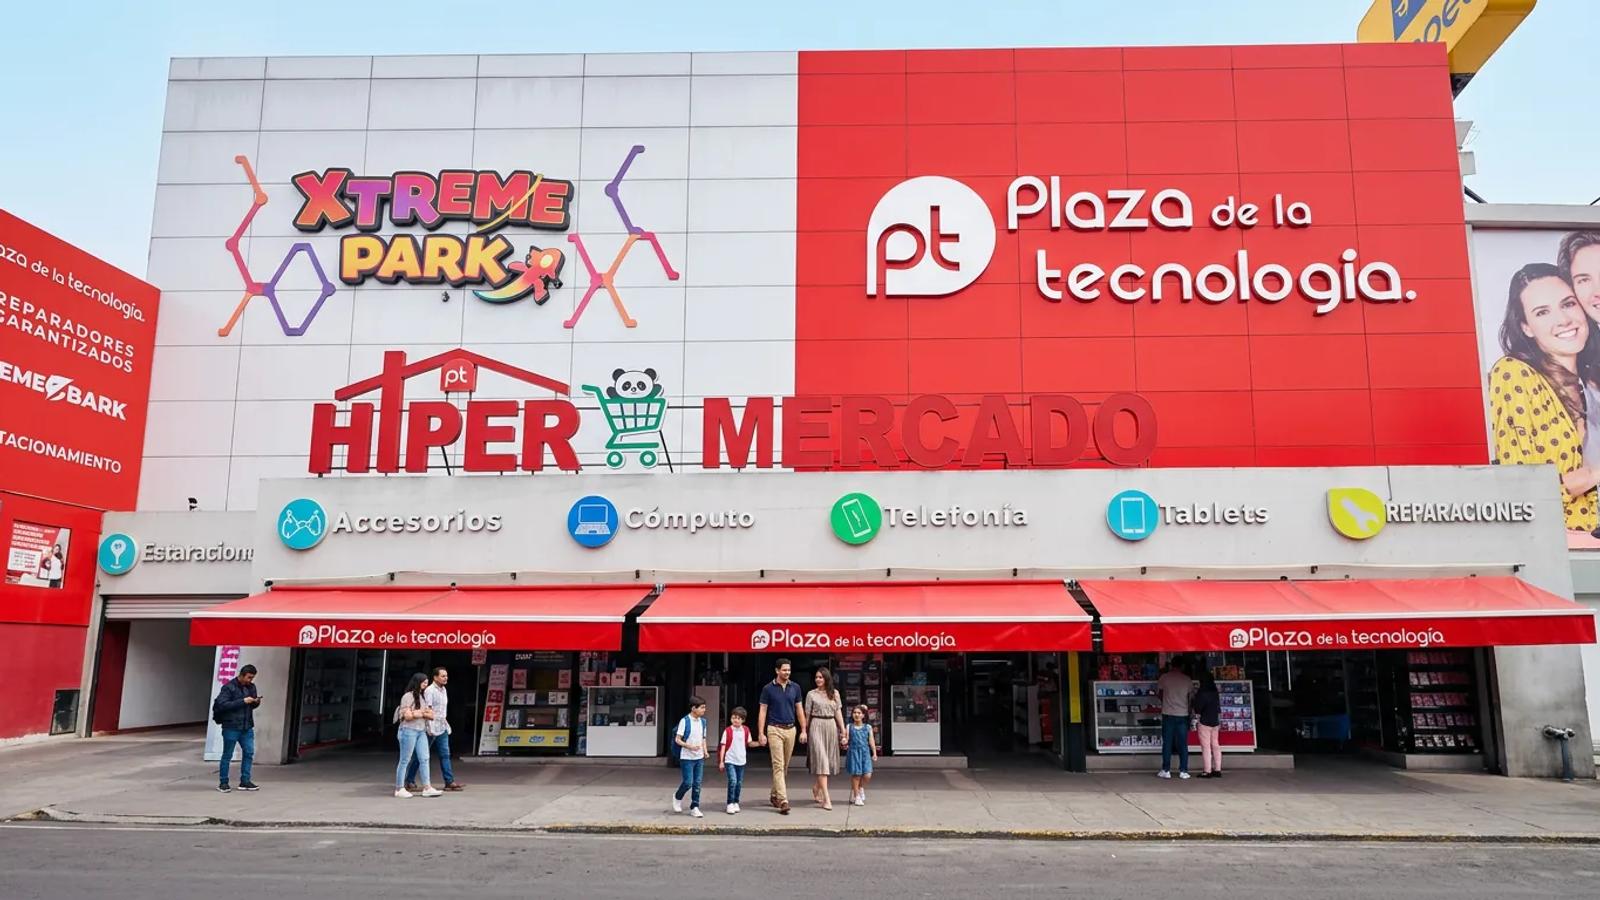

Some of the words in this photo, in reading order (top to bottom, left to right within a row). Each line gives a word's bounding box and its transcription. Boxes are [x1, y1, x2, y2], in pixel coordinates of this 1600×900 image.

[292, 168, 574, 231] XTREME
[1007, 175, 1193, 230] Plaza
[1211, 196, 1259, 227] de
[1275, 193, 1311, 226] la
[31, 260, 50, 278] de
[52, 267, 65, 285] la
[339, 233, 514, 287] PARK
[445, 366, 468, 388] pt
[308, 350, 582, 474] HIPER
[702, 392, 1159, 469] MERCADO
[332, 508, 502, 534] Accesorios
[624, 506, 756, 534] Cómputo
[884, 502, 1028, 528] Telefonía
[1160, 501, 1270, 526] Tablets
[1385, 501, 1535, 523] REPARACIONES
[318, 624, 375, 643] Plaza
[379, 631, 394, 643] de
[397, 631, 408, 643] la
[411, 629, 496, 648] tecnología
[771, 629, 831, 648] Plaza
[835, 636, 850, 647] de
[853, 635, 864, 647] la
[867, 631, 956, 650] tecnología
[1249, 627, 1312, 646] Plaza
[1317, 633, 1333, 645] de
[1336, 632, 1348, 645] la
[1351, 627, 1445, 647] tecnología
